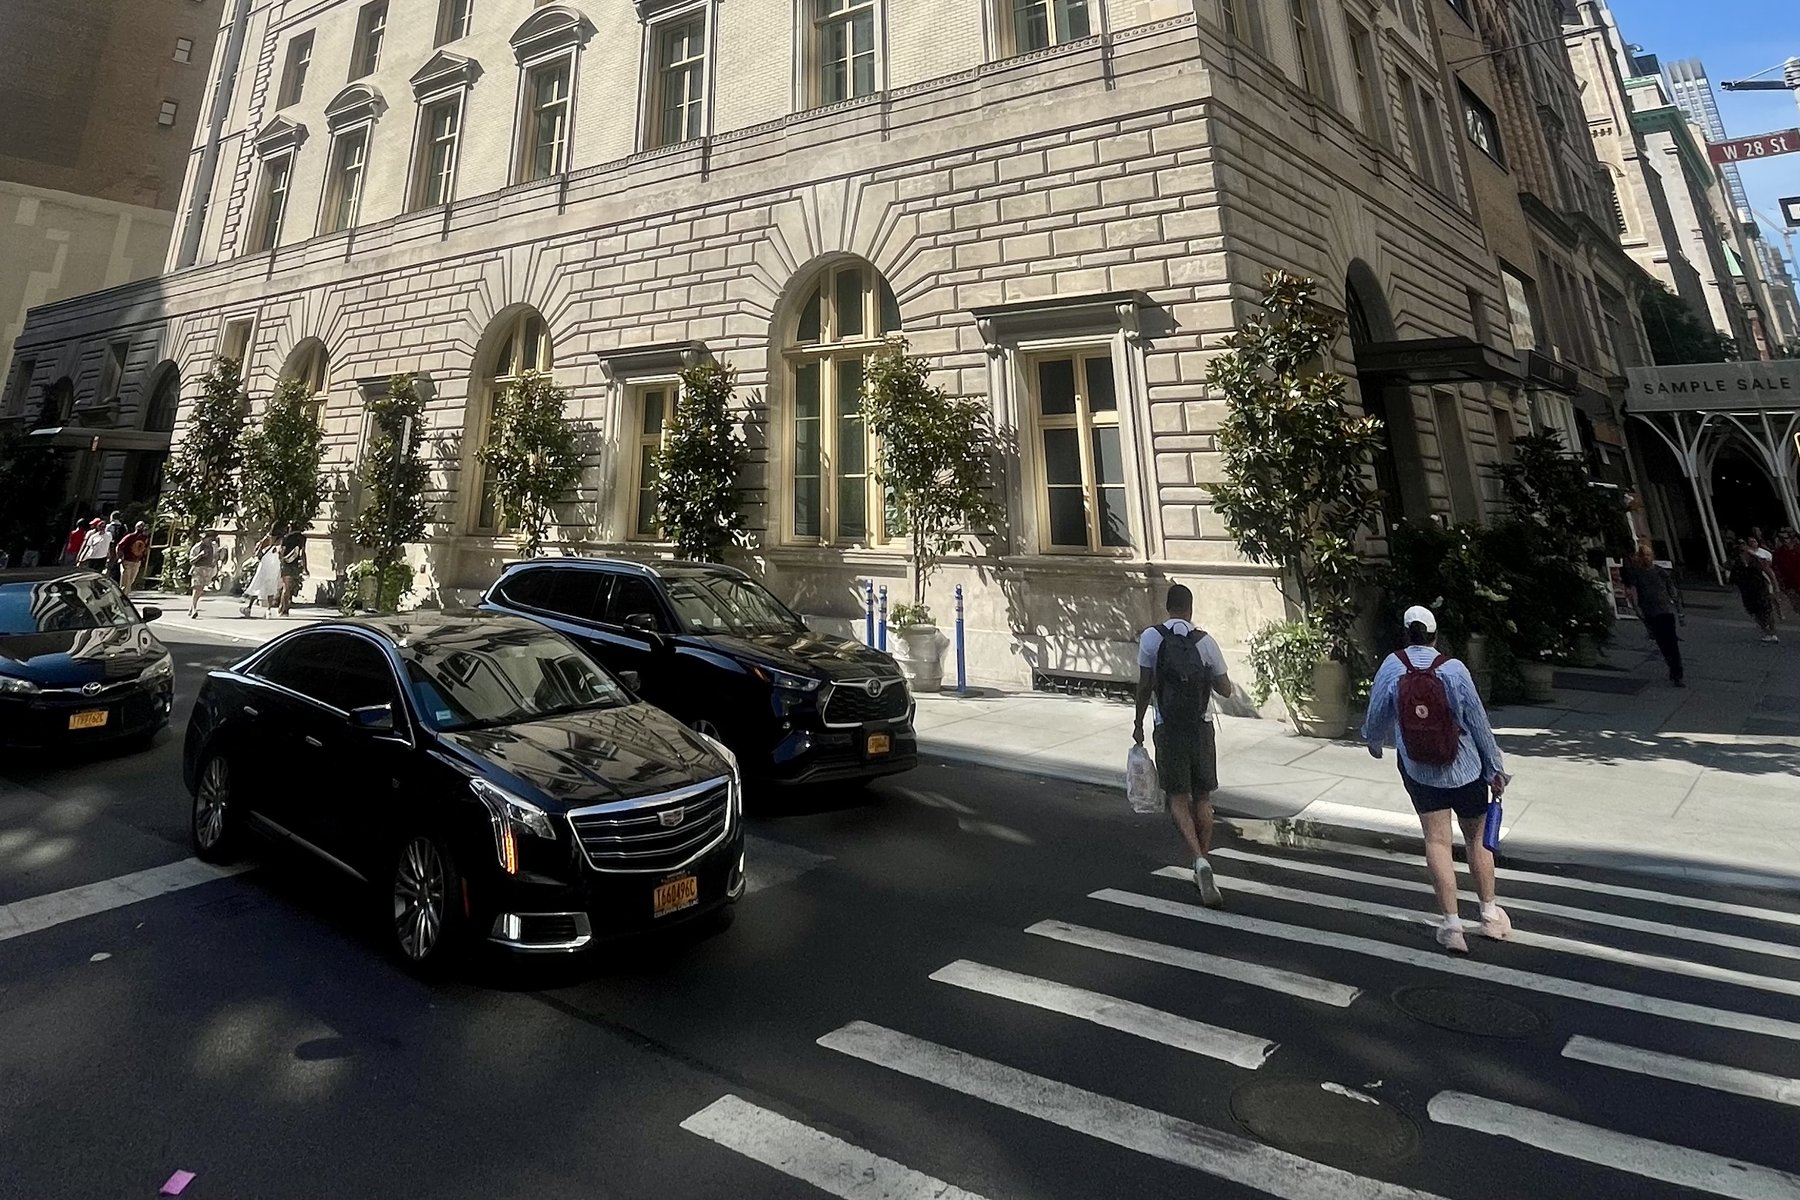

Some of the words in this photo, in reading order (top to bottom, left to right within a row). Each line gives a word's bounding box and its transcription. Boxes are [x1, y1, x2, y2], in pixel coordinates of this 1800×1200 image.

[1722, 145, 1738, 160] W
[1743, 141, 1765, 157] 28
[1770, 136, 1789, 153] St
[1643, 380, 1727, 395] SAMPLE
[1736, 377, 1792, 391] SALE
